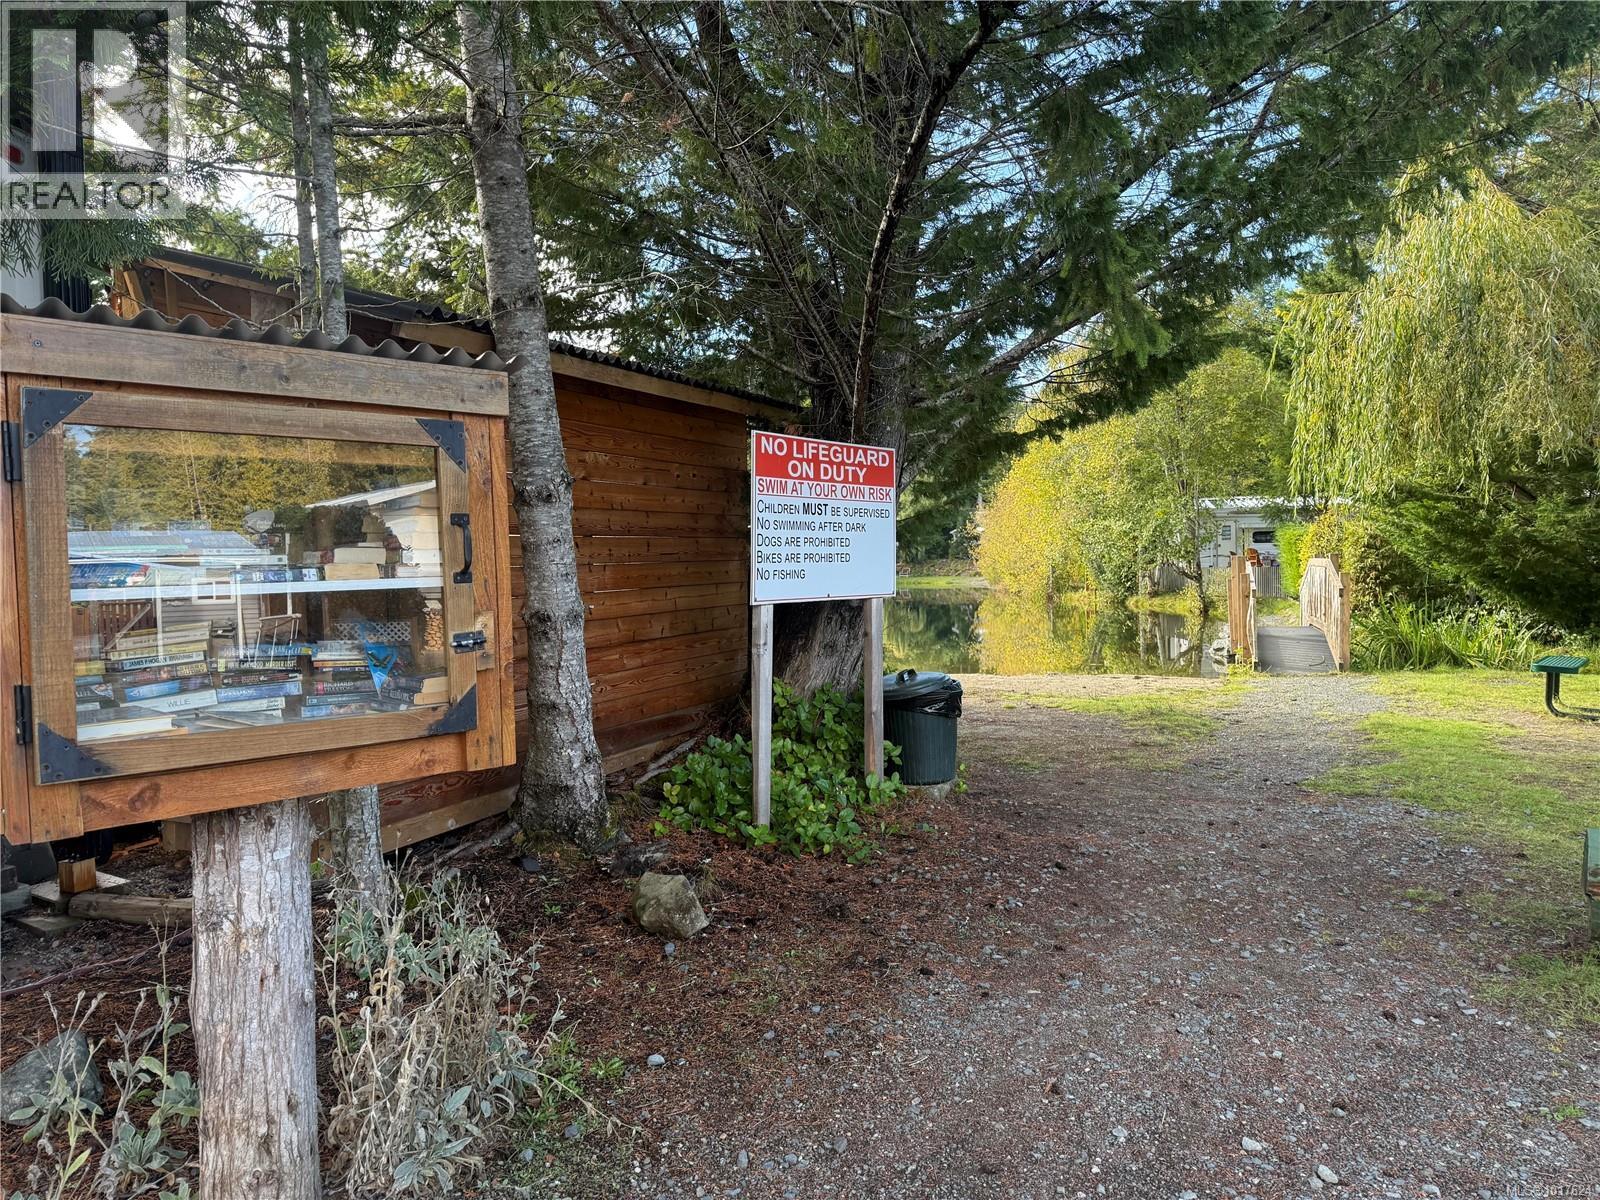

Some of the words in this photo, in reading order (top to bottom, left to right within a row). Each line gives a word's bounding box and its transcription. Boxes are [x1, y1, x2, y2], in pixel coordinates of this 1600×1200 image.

[760, 436, 787, 457] NO
[793, 440, 890, 468] LIFEGUARD
[787, 460, 814, 479] ON
[820, 463, 867, 483] DUTY
[757, 478, 788, 495] SWIM
[791, 481, 804, 496] AT
[807, 482, 837, 498] YOUR
[841, 485, 865, 500] OWN
[869, 487, 892, 501] RISK
[802, 502, 829, 516] MUST
[831, 506, 841, 517] BE
[843, 507, 890, 519] SUPERVISED
[773, 519, 816, 532] SWIMMING
[818, 521, 843, 532] AFTER
[846, 522, 866, 533] DARK
[784, 536, 801, 547] ARE
[803, 537, 851, 547] PROHIBITED
[784, 552, 801, 563] ARE
[803, 552, 851, 563] PROHIBITED
[772, 569, 806, 580] FISHING
